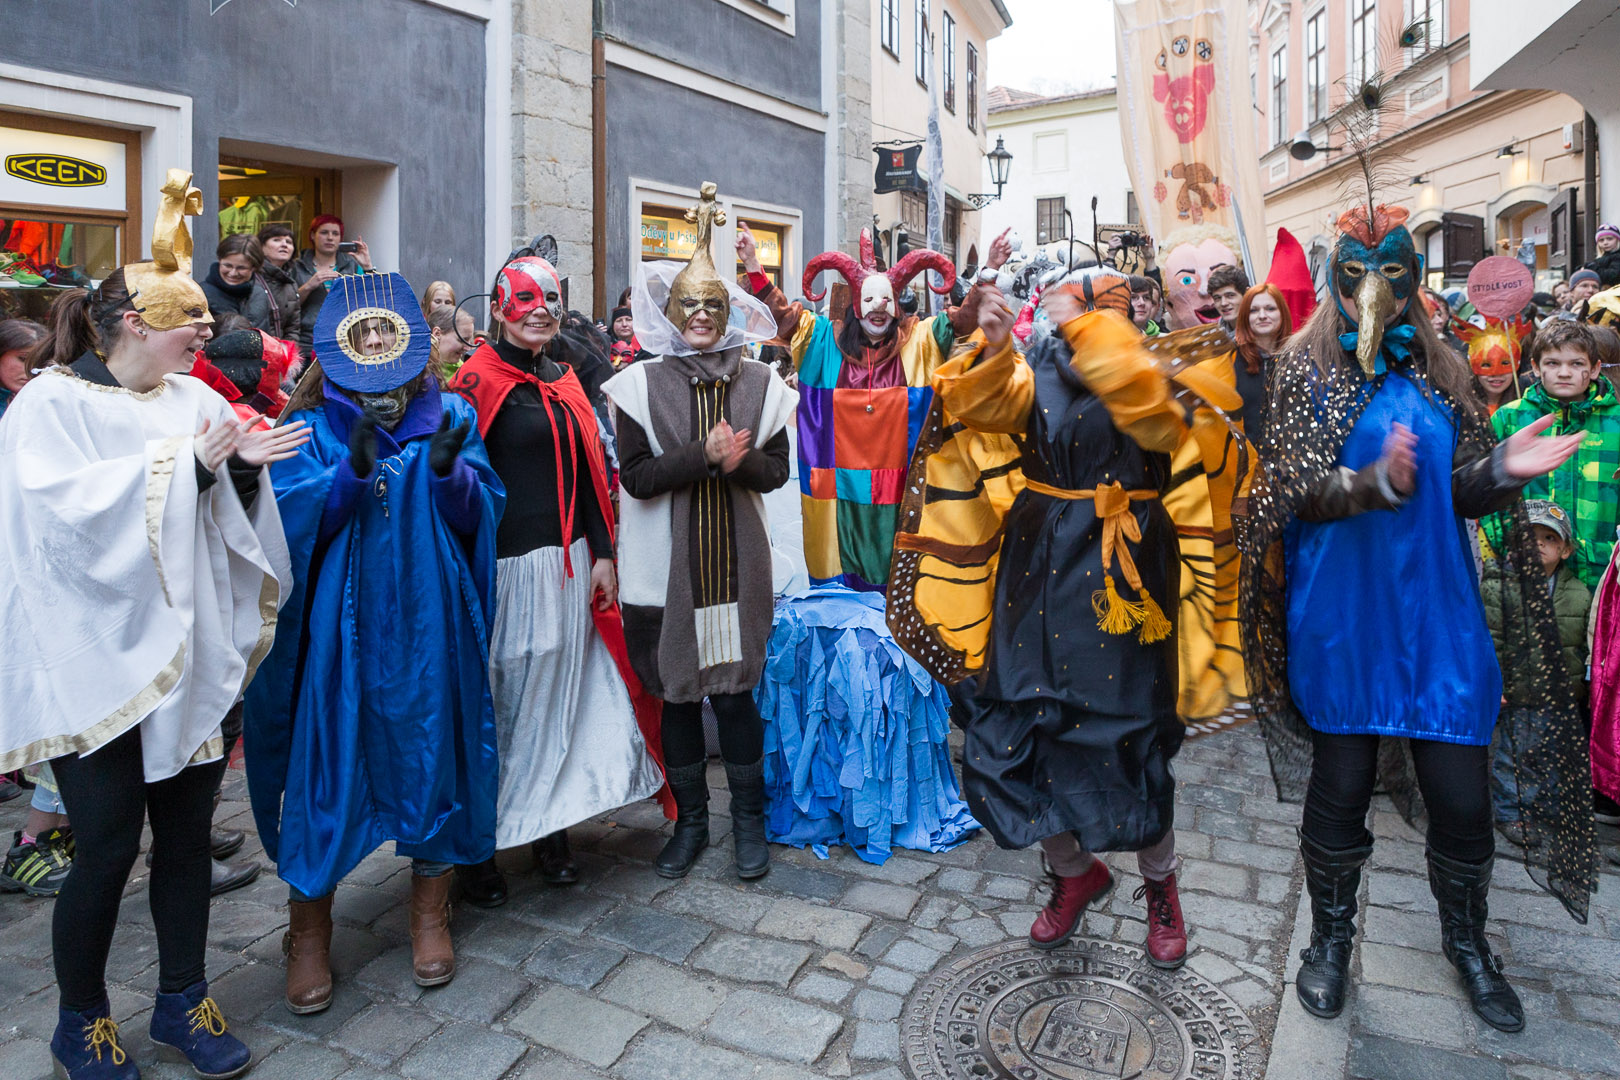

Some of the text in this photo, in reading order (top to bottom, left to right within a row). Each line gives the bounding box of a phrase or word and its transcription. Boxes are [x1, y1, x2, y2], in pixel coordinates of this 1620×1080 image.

[11, 159, 103, 182] KEEN
[641, 225, 667, 242] Oděvy
[669, 231, 675, 240] u
